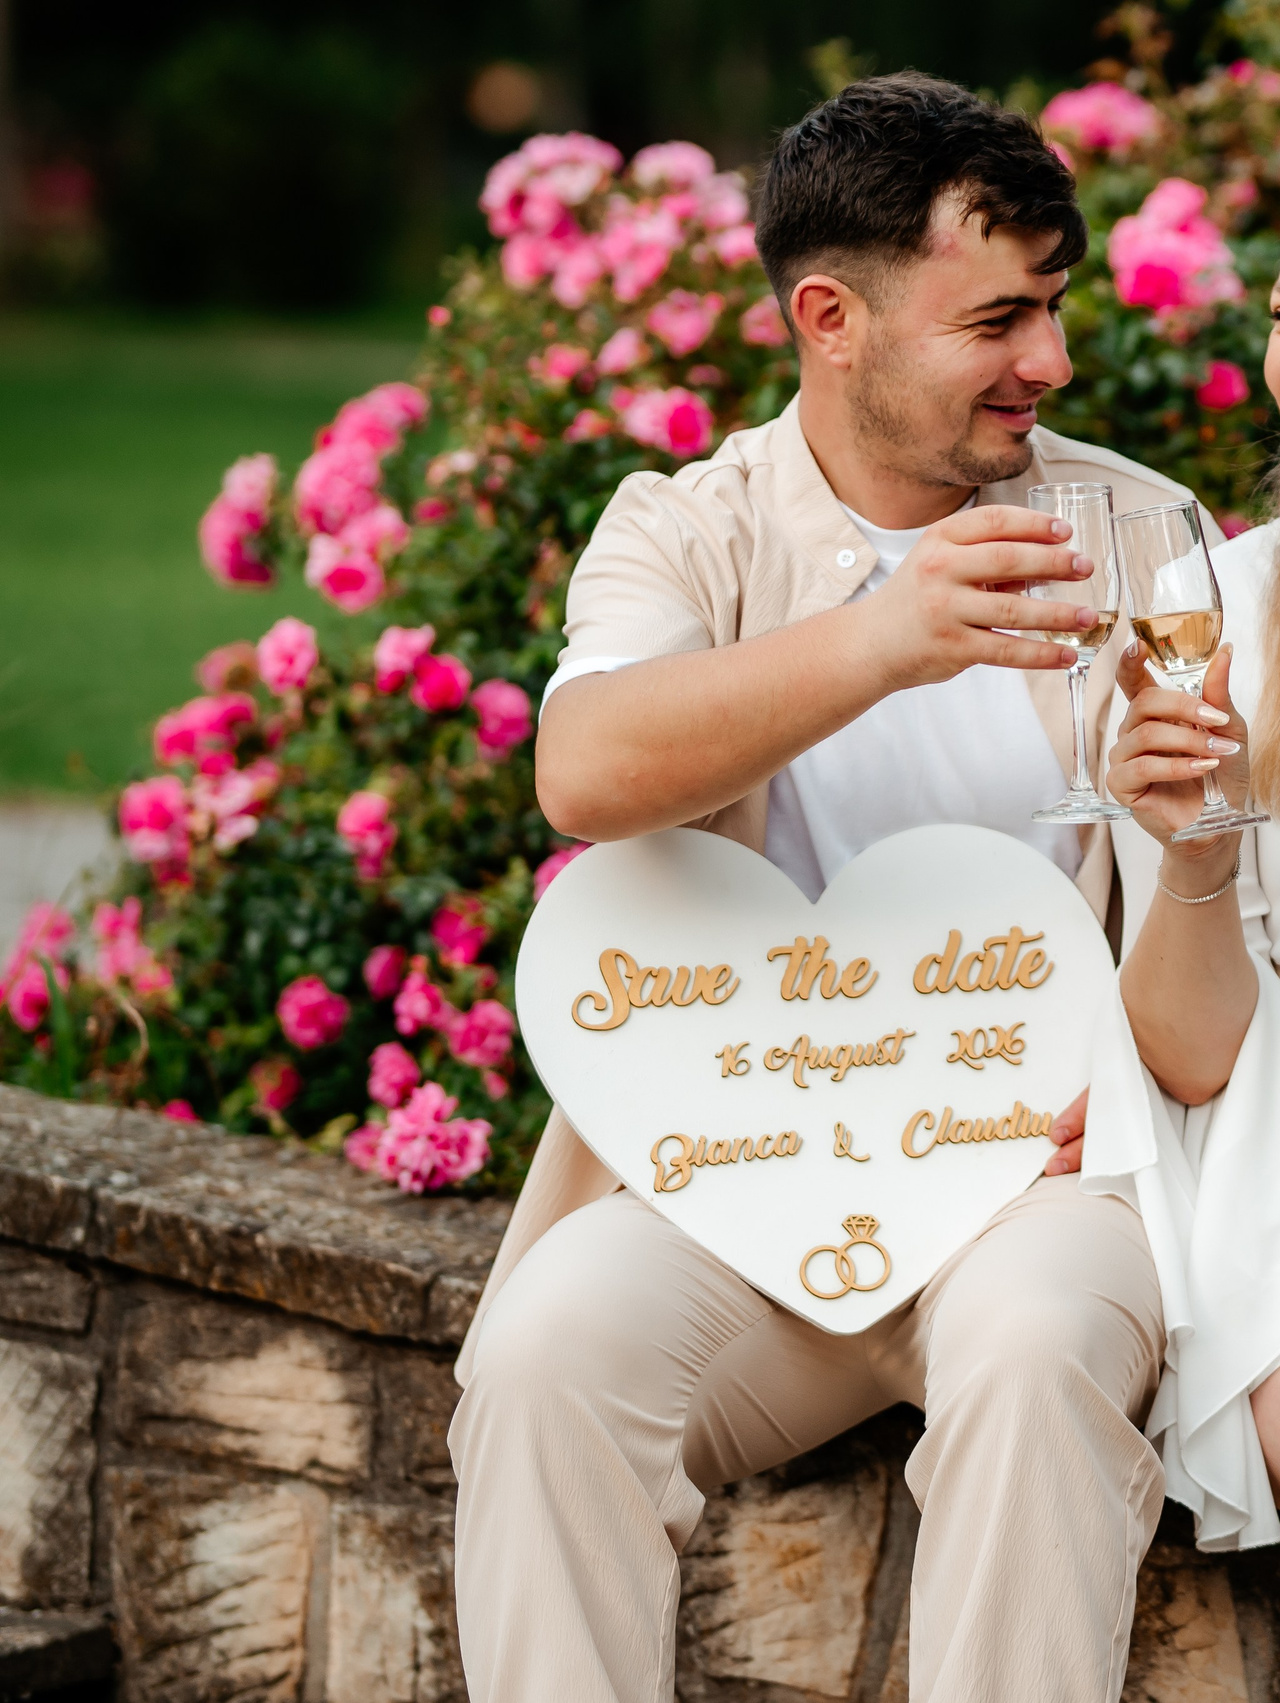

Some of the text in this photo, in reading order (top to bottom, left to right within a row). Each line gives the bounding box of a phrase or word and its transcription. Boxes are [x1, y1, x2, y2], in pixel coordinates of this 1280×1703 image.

[572, 926, 1054, 1031] Save the date
[716, 1022, 1025, 1088] 16 August 2026
[650, 1132, 802, 1192] Bianca
[834, 1122, 870, 1162] &
